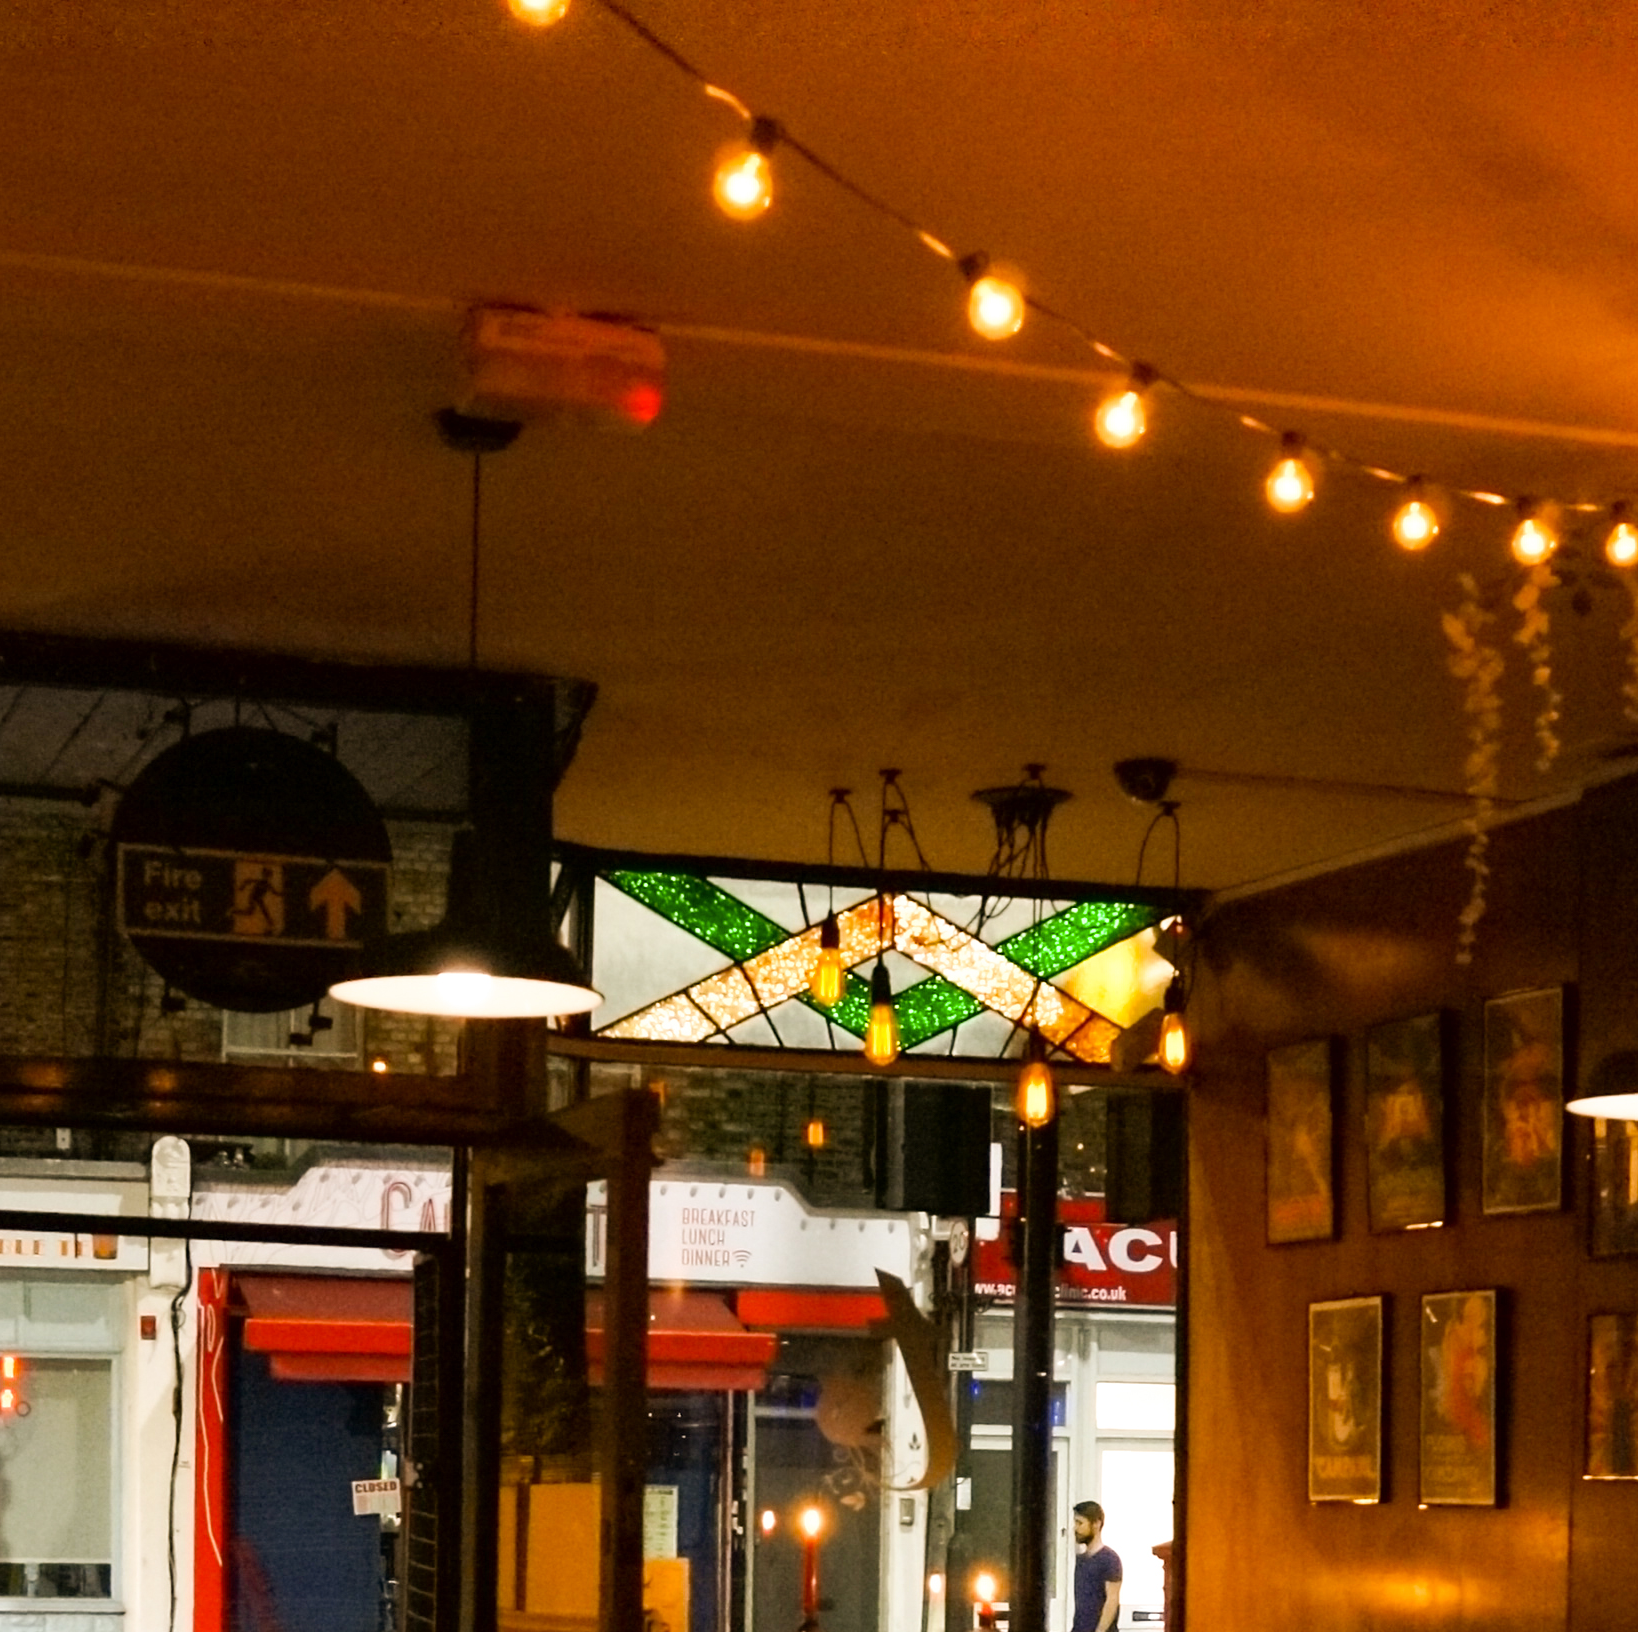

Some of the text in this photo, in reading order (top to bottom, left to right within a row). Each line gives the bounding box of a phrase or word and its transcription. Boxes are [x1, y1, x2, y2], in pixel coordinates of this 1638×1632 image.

[144, 861, 202, 890] Fire
[143, 898, 202, 923] exit
[682, 1207, 755, 1227] BREAKFAST
[682, 1228, 725, 1245] LUNCH
[681, 1248, 730, 1266] DINNER
[355, 1481, 397, 1494] CLOSED
